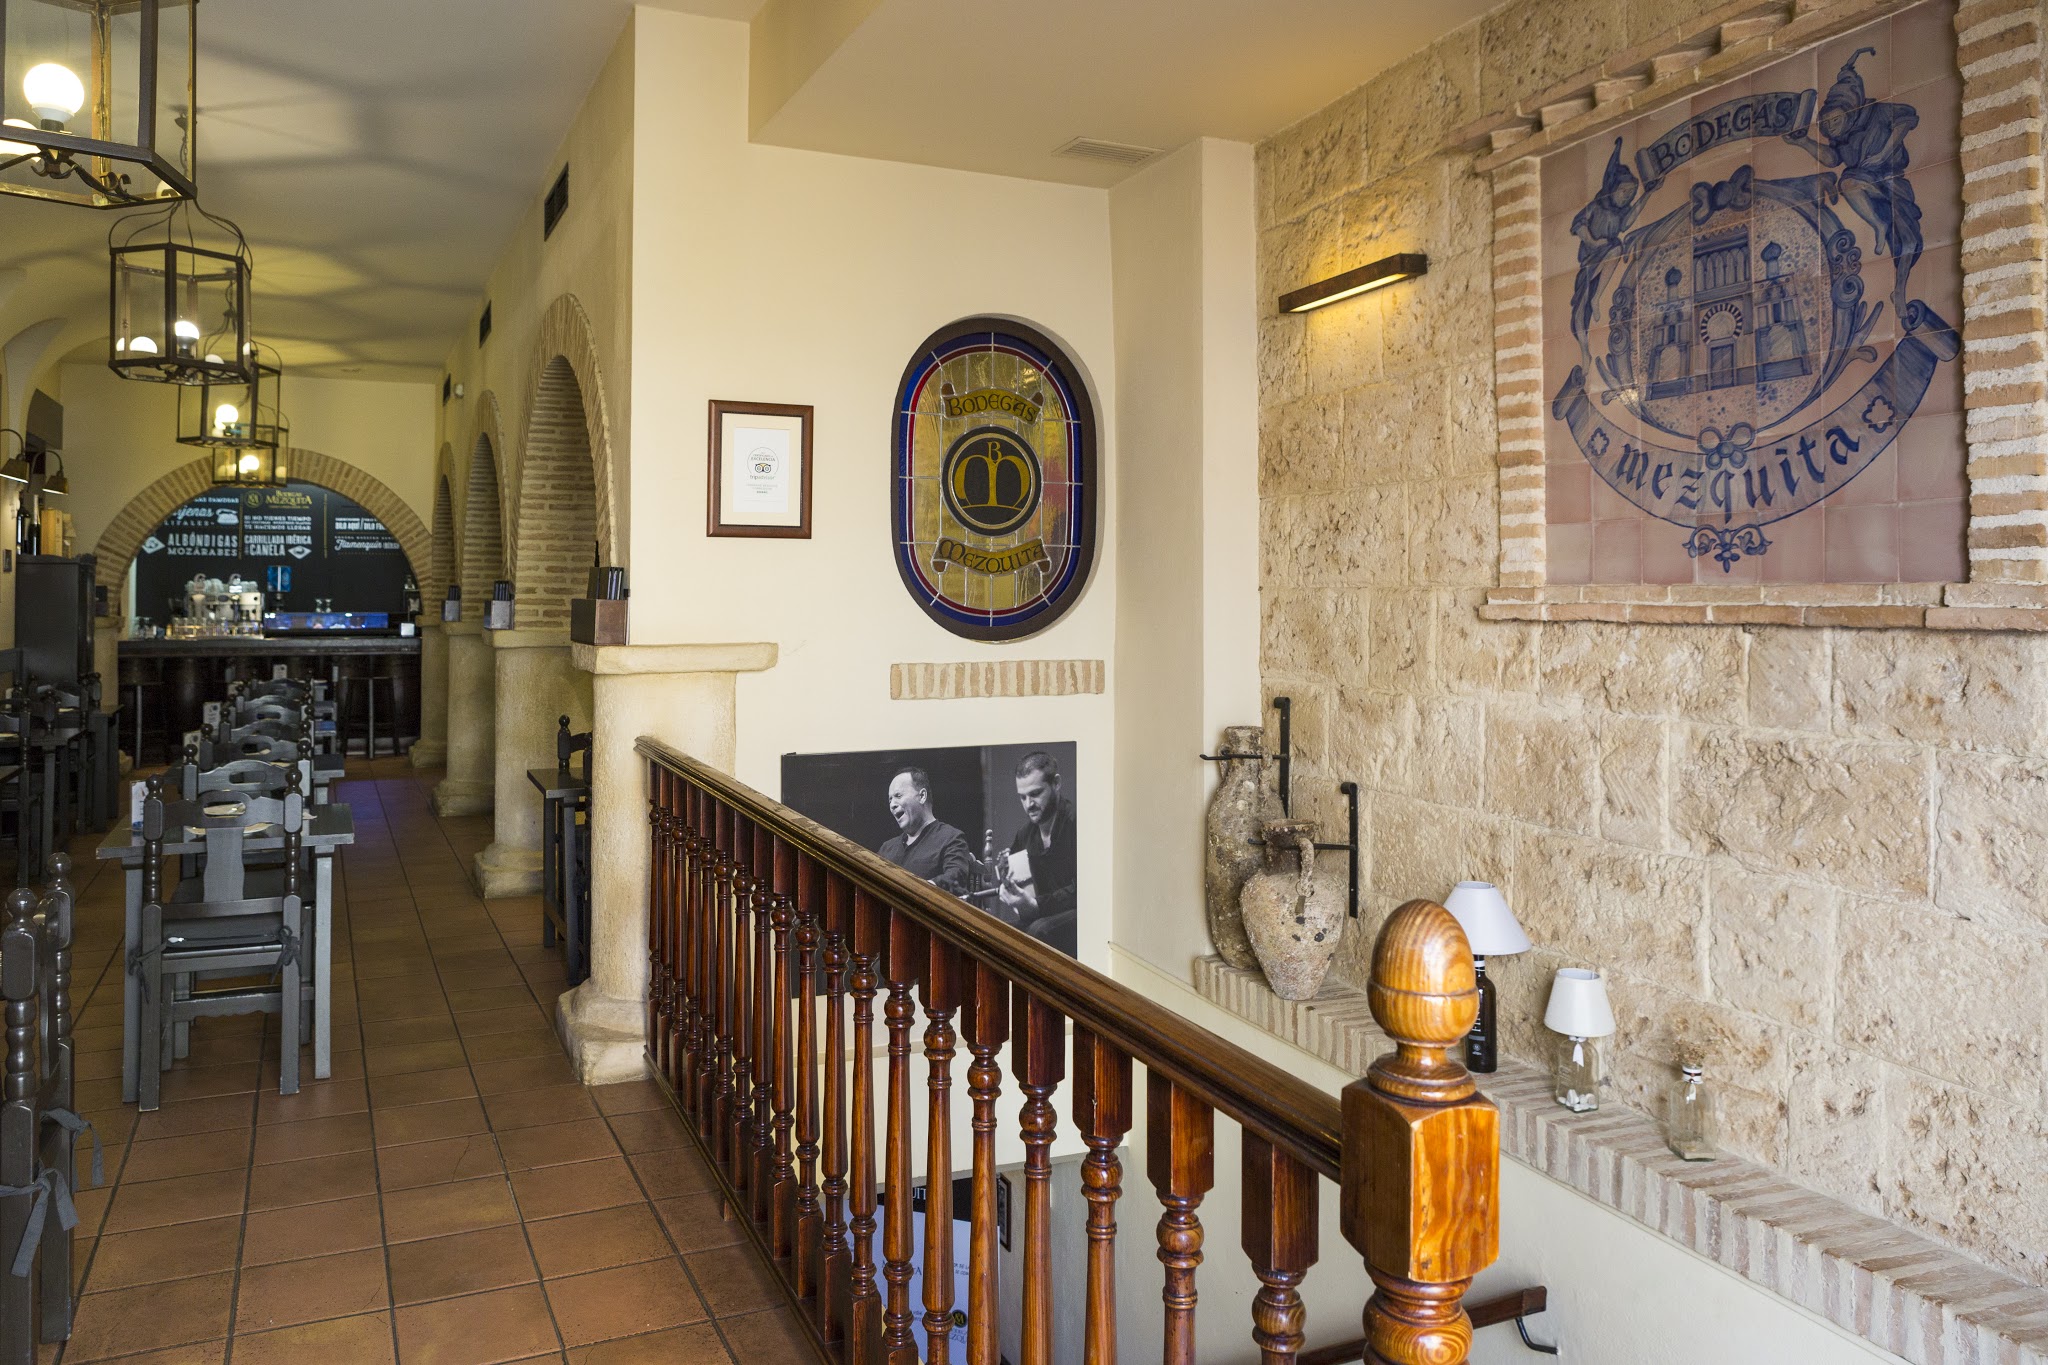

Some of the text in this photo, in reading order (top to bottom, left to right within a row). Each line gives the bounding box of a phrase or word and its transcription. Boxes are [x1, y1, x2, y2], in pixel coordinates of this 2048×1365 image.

[1656, 98, 1793, 171] BODEGAS
[949, 393, 1038, 423] BODEGAS
[167, 531, 238, 548] ALBÓNDIGAS
[167, 545, 238, 556] MOZÁRABES
[249, 544, 286, 557] CANELA
[938, 540, 1046, 574] MEZQUITA
